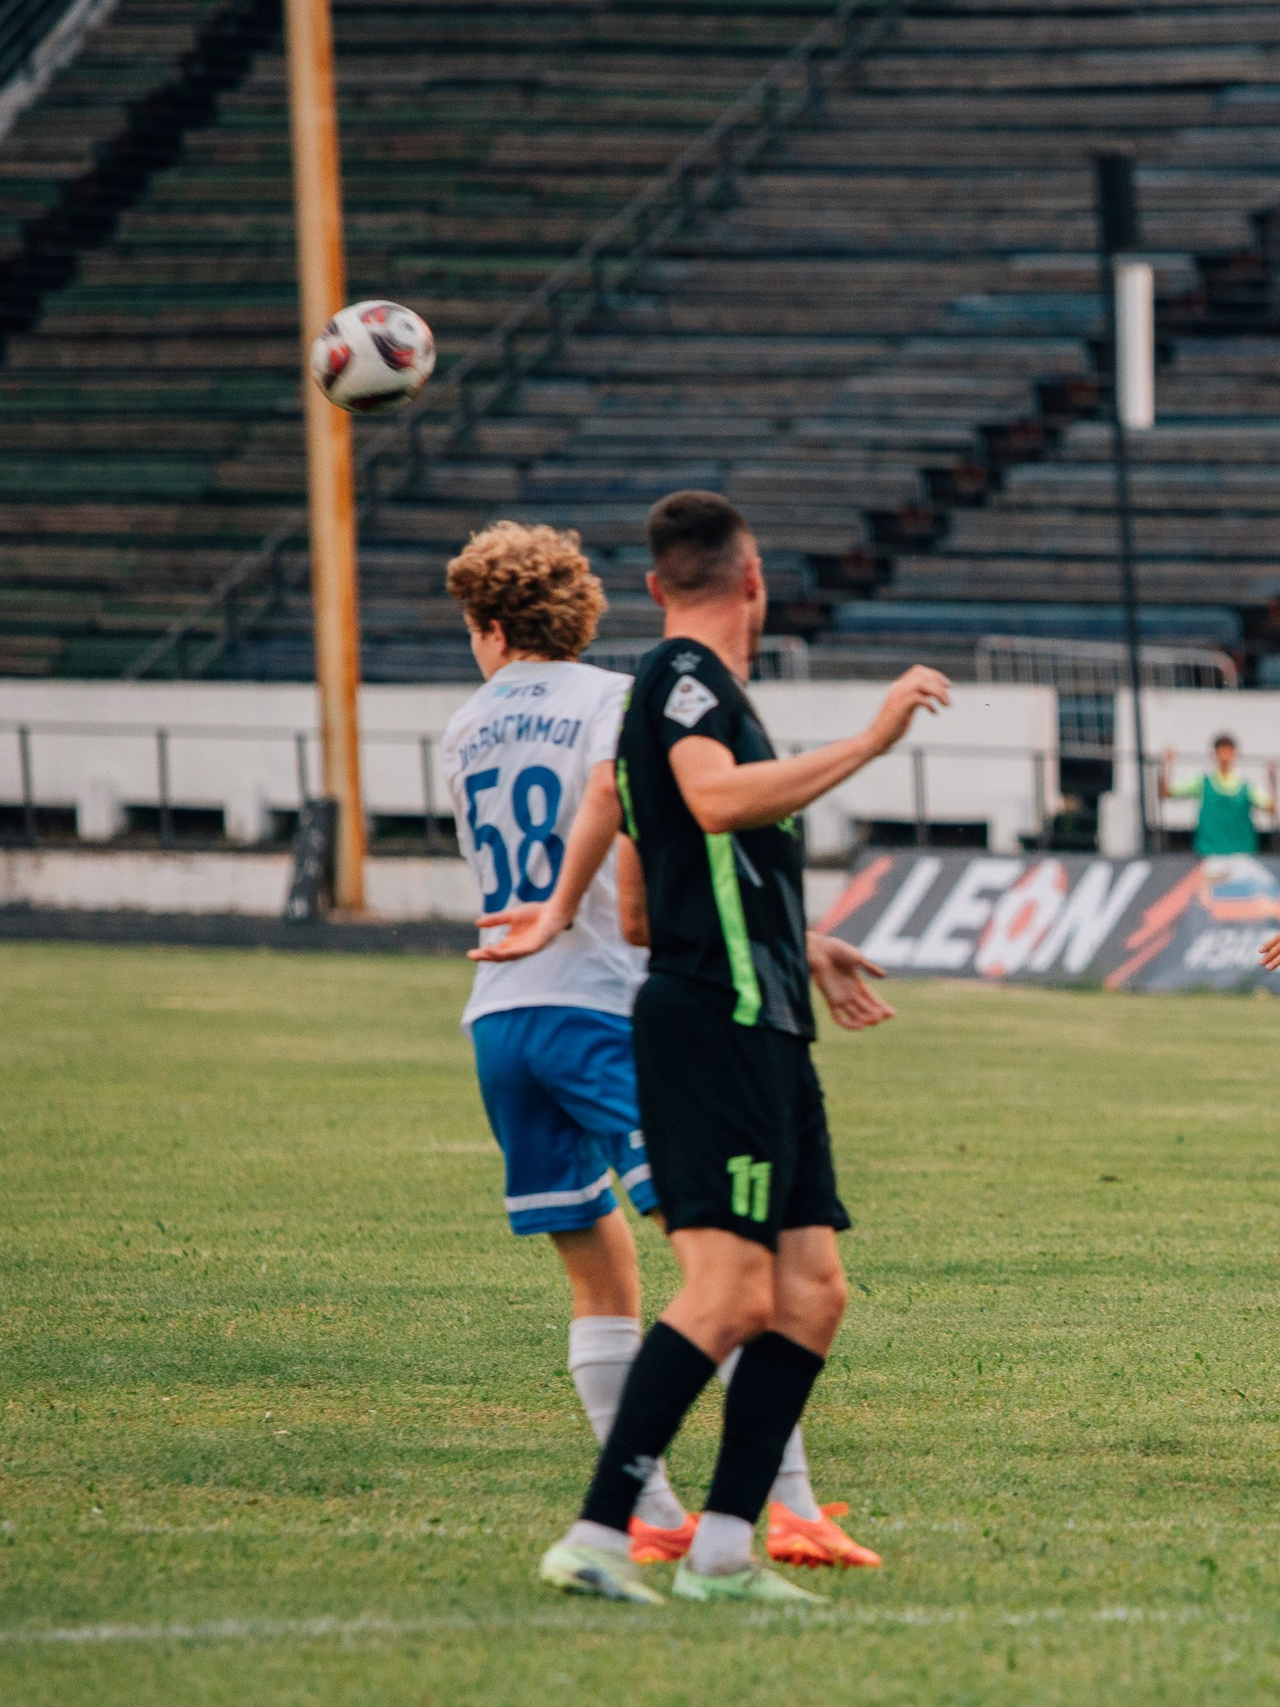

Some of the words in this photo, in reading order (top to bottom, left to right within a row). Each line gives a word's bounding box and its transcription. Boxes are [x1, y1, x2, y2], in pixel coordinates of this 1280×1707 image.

[465, 764, 564, 914] 58
[859, 856, 1150, 976] LEON
[727, 1154, 772, 1223] 11
